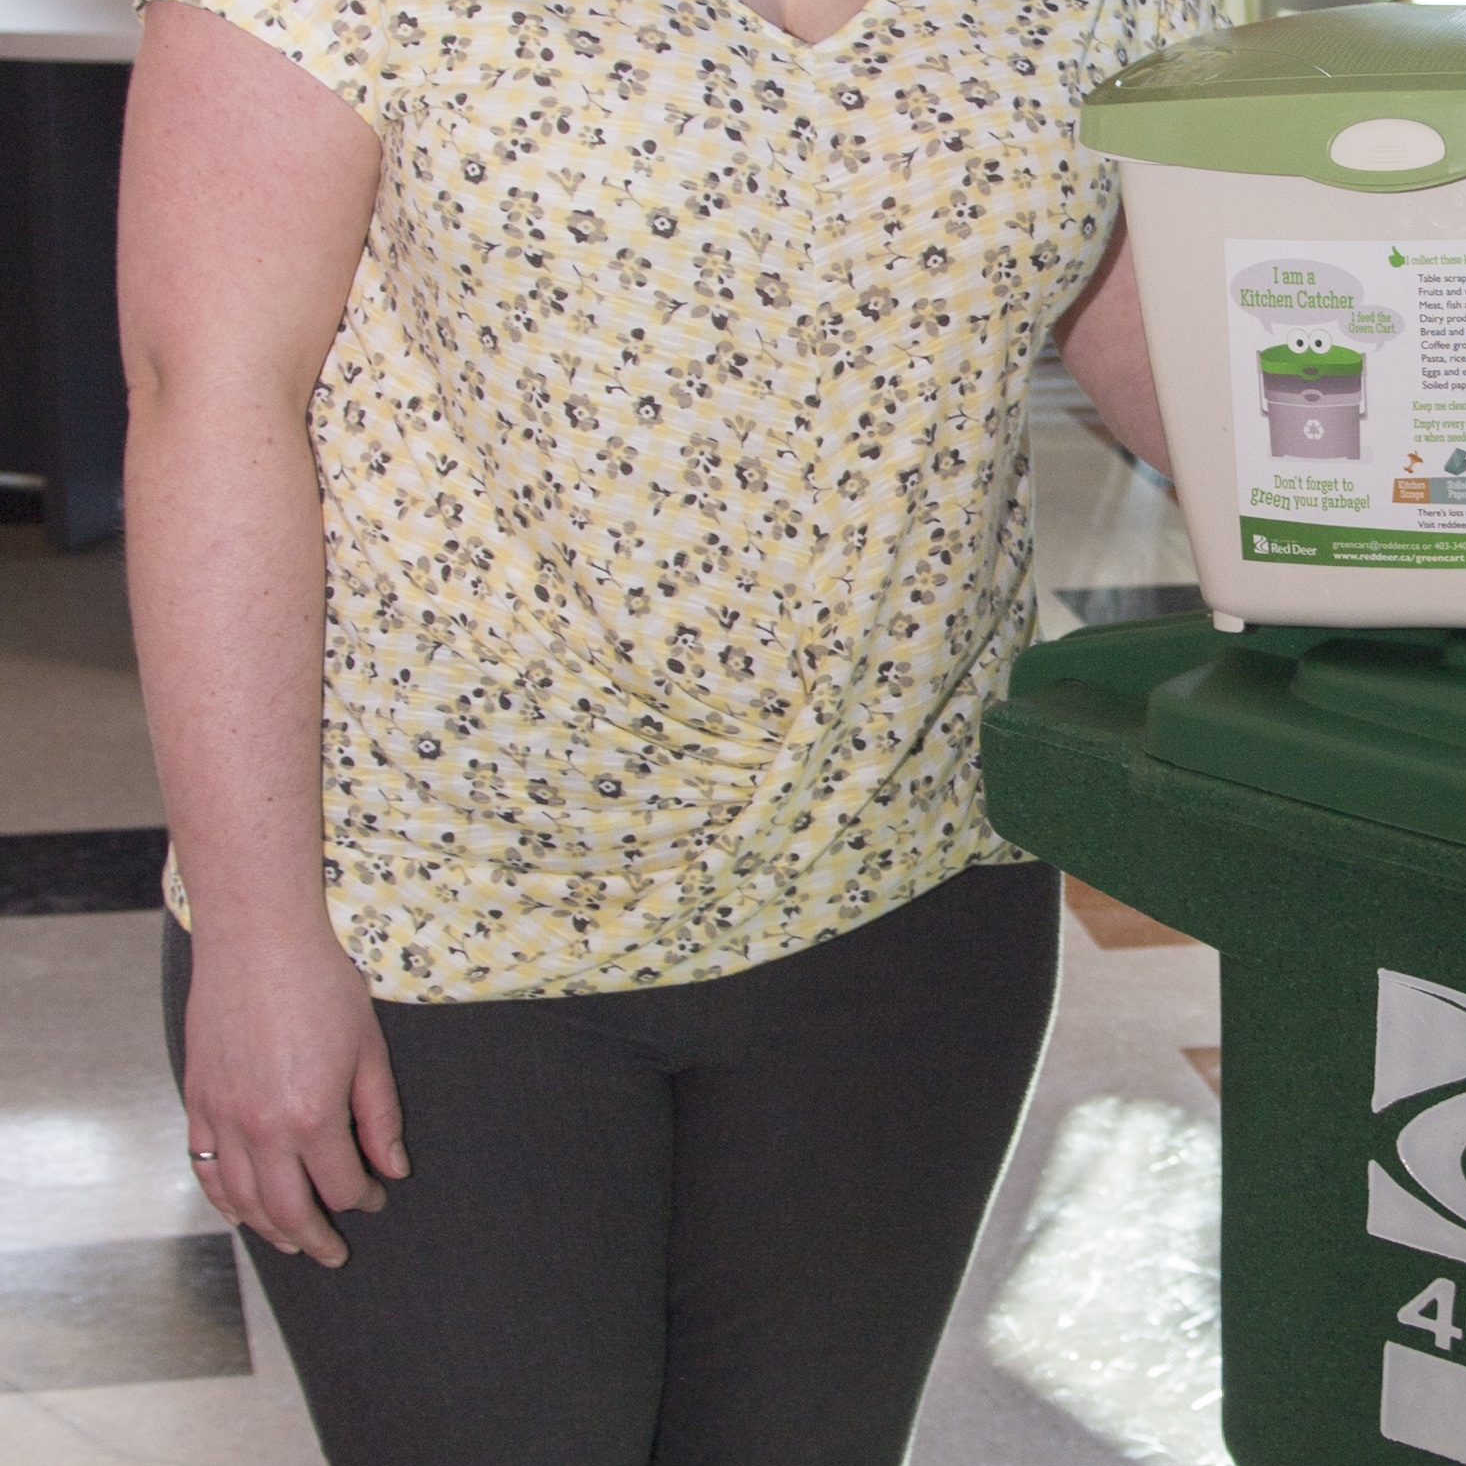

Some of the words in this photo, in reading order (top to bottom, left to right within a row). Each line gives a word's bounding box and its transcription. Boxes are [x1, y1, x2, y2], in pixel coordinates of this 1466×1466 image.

[1412, 255, 1438, 265] collect
[1441, 255, 1461, 264] these
[1273, 267, 1279, 283] I
[1282, 271, 1303, 284] am
[1307, 271, 1315, 284] a
[1418, 274, 1441, 283] Table
[1419, 288, 1443, 296] Fruits
[1446, 287, 1462, 295] and
[1240, 289, 1293, 308] Kitchen
[1297, 290, 1354, 308] Catcher
[1419, 301, 1444, 309] Meat,
[1447, 300, 1462, 309] fish
[1357, 312, 1375, 322] feed
[1378, 312, 1390, 322] the
[1420, 315, 1443, 324] Dairy
[1348, 323, 1373, 333] Green
[1376, 323, 1397, 333] Cart.
[1421, 328, 1445, 336] Bread
[1421, 341, 1450, 349] Coffee
[1422, 354, 1446, 363] Pasta,
[1422, 368, 1440, 378] Eggs
[1413, 401, 1432, 412] Keep
[1414, 419, 1439, 431] Empty
[1442, 420, 1463, 430] every
[1425, 434, 1445, 442] when
[1274, 475, 1303, 490] Don't
[1306, 477, 1339, 494] forget
[1343, 479, 1353, 492] to
[1251, 487, 1290, 510] green
[1293, 495, 1318, 511] your
[1322, 495, 1370, 512] garbage!
[1418, 509, 1446, 517] There's
[1271, 543, 1291, 554] Red
[1292, 544, 1317, 556] Deer
[1333, 553, 1465, 563] www.reddeer.ca/greencart
